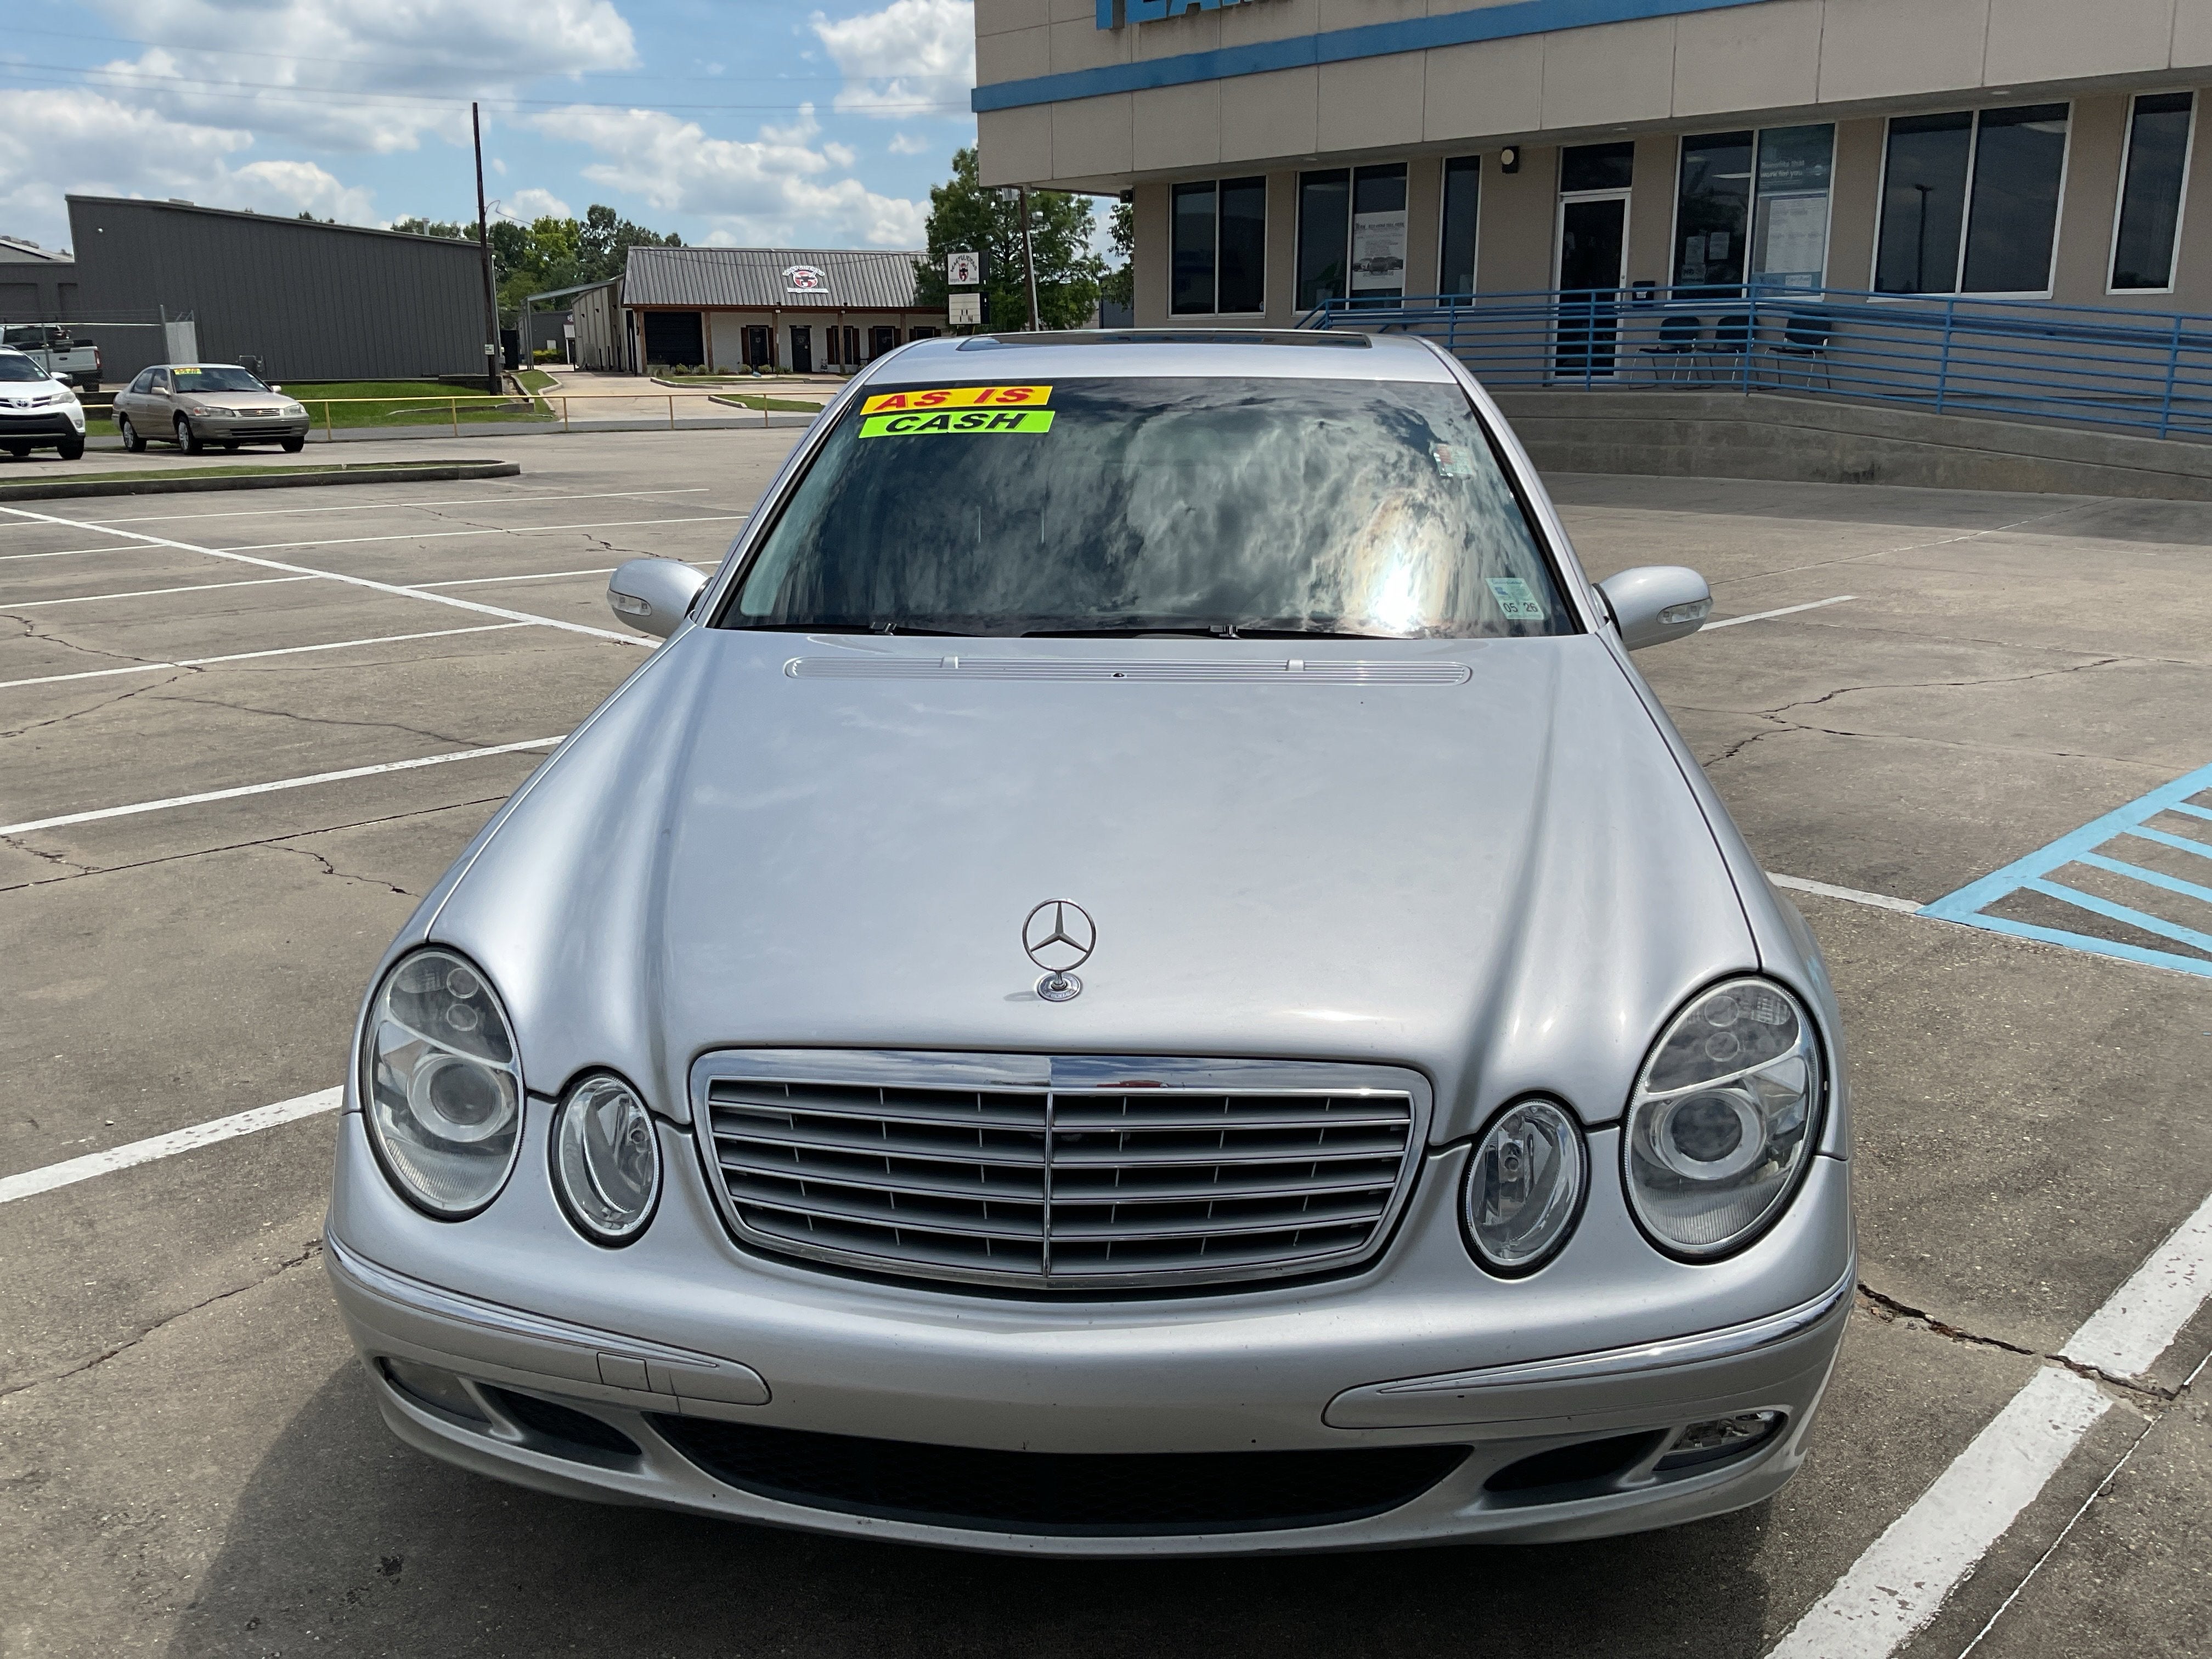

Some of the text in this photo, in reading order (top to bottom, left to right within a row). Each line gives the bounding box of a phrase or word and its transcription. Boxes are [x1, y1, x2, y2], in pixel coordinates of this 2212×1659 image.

[873, 388, 1035, 411] AS IS
[885, 413, 1028, 432] CASH
[1503, 602, 1538, 613] 05 26
